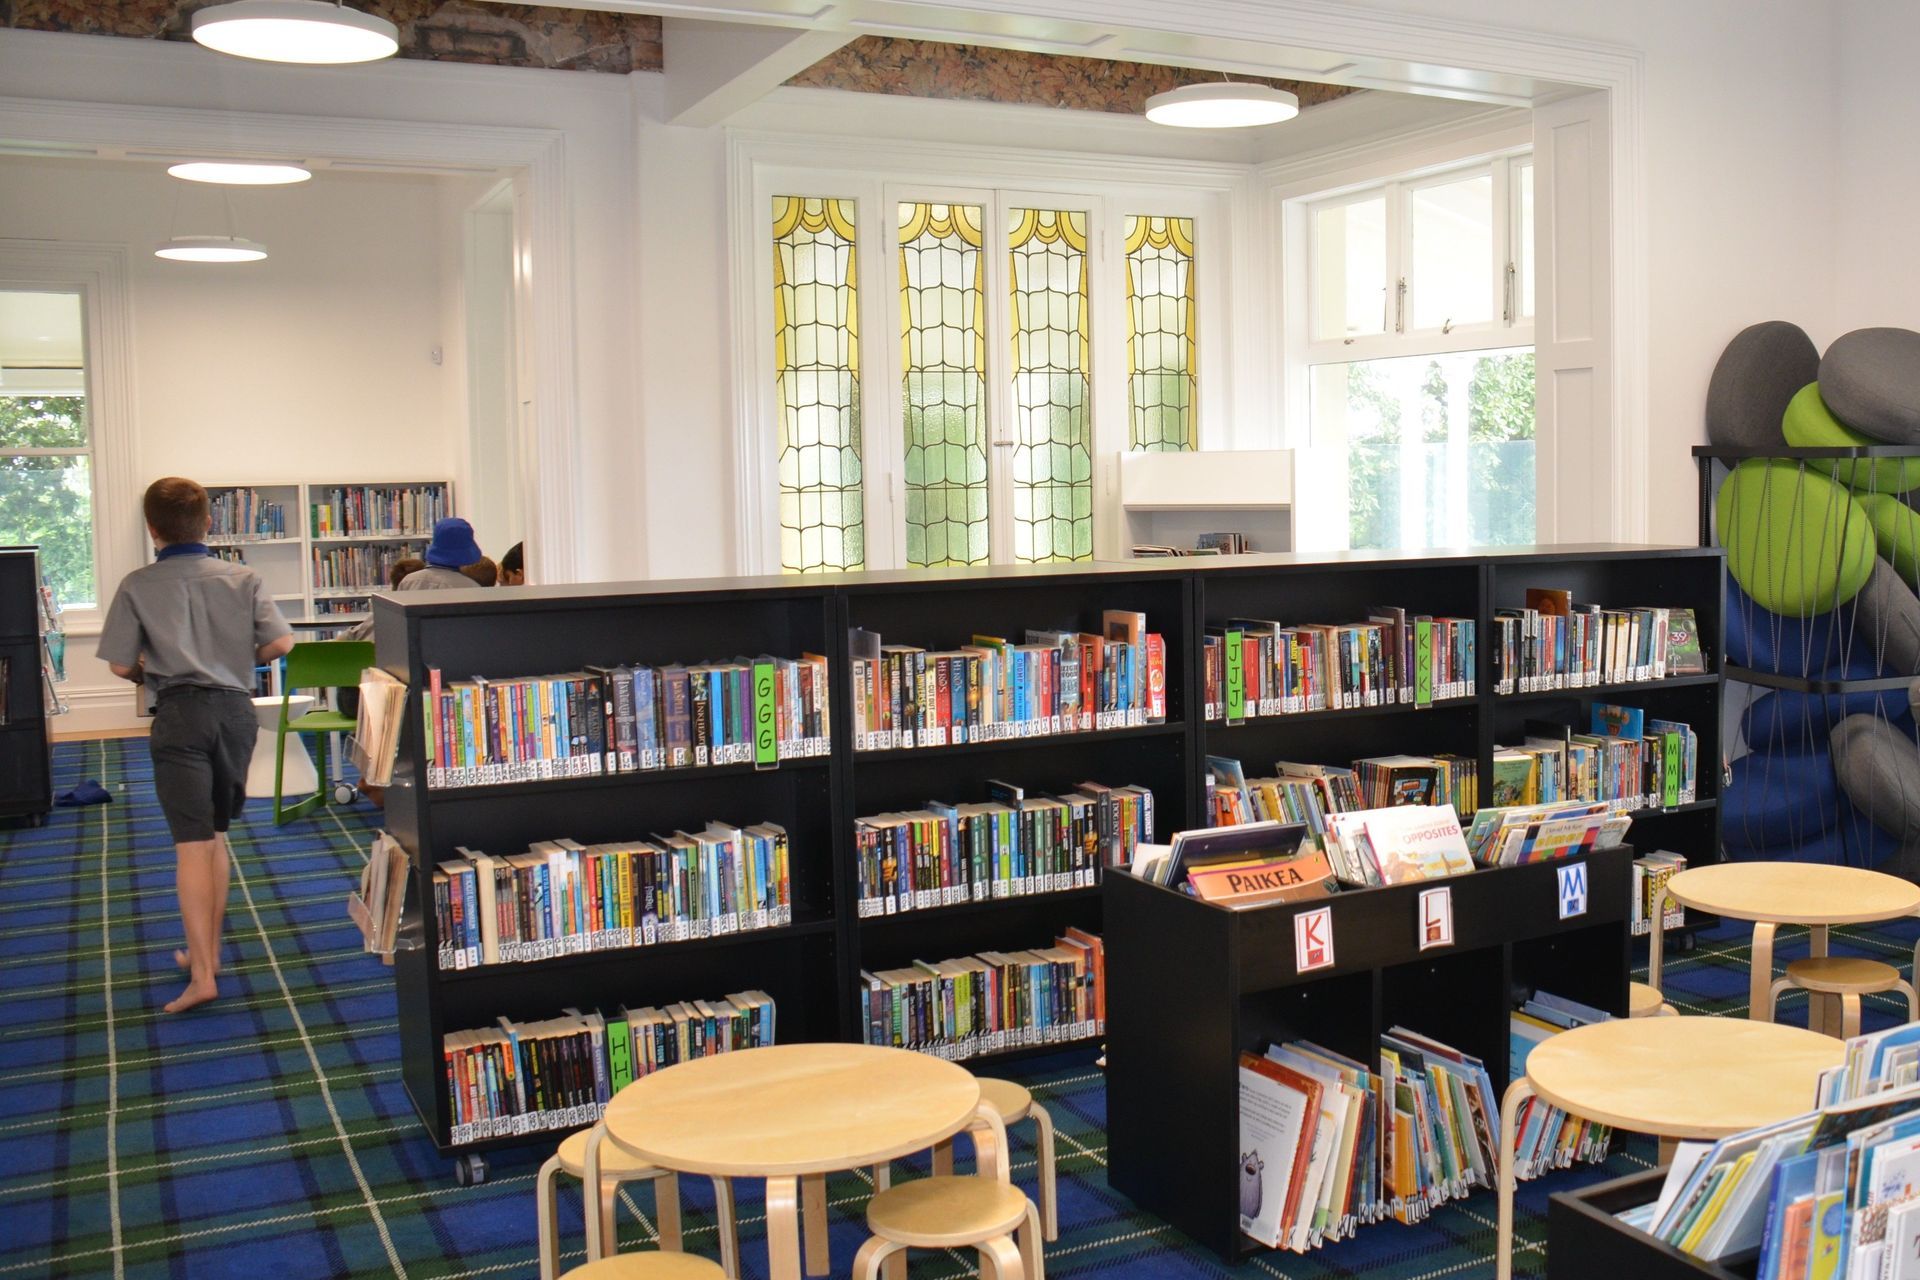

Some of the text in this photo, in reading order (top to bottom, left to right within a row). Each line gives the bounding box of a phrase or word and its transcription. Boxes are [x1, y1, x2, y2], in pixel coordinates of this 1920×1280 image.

[1402, 824, 1459, 845] OPPOSITES
[1226, 867, 1304, 894] PAIKEA
[1562, 869, 1585, 900] M
[1425, 895, 1441, 927] L
[1304, 914, 1325, 950] K
